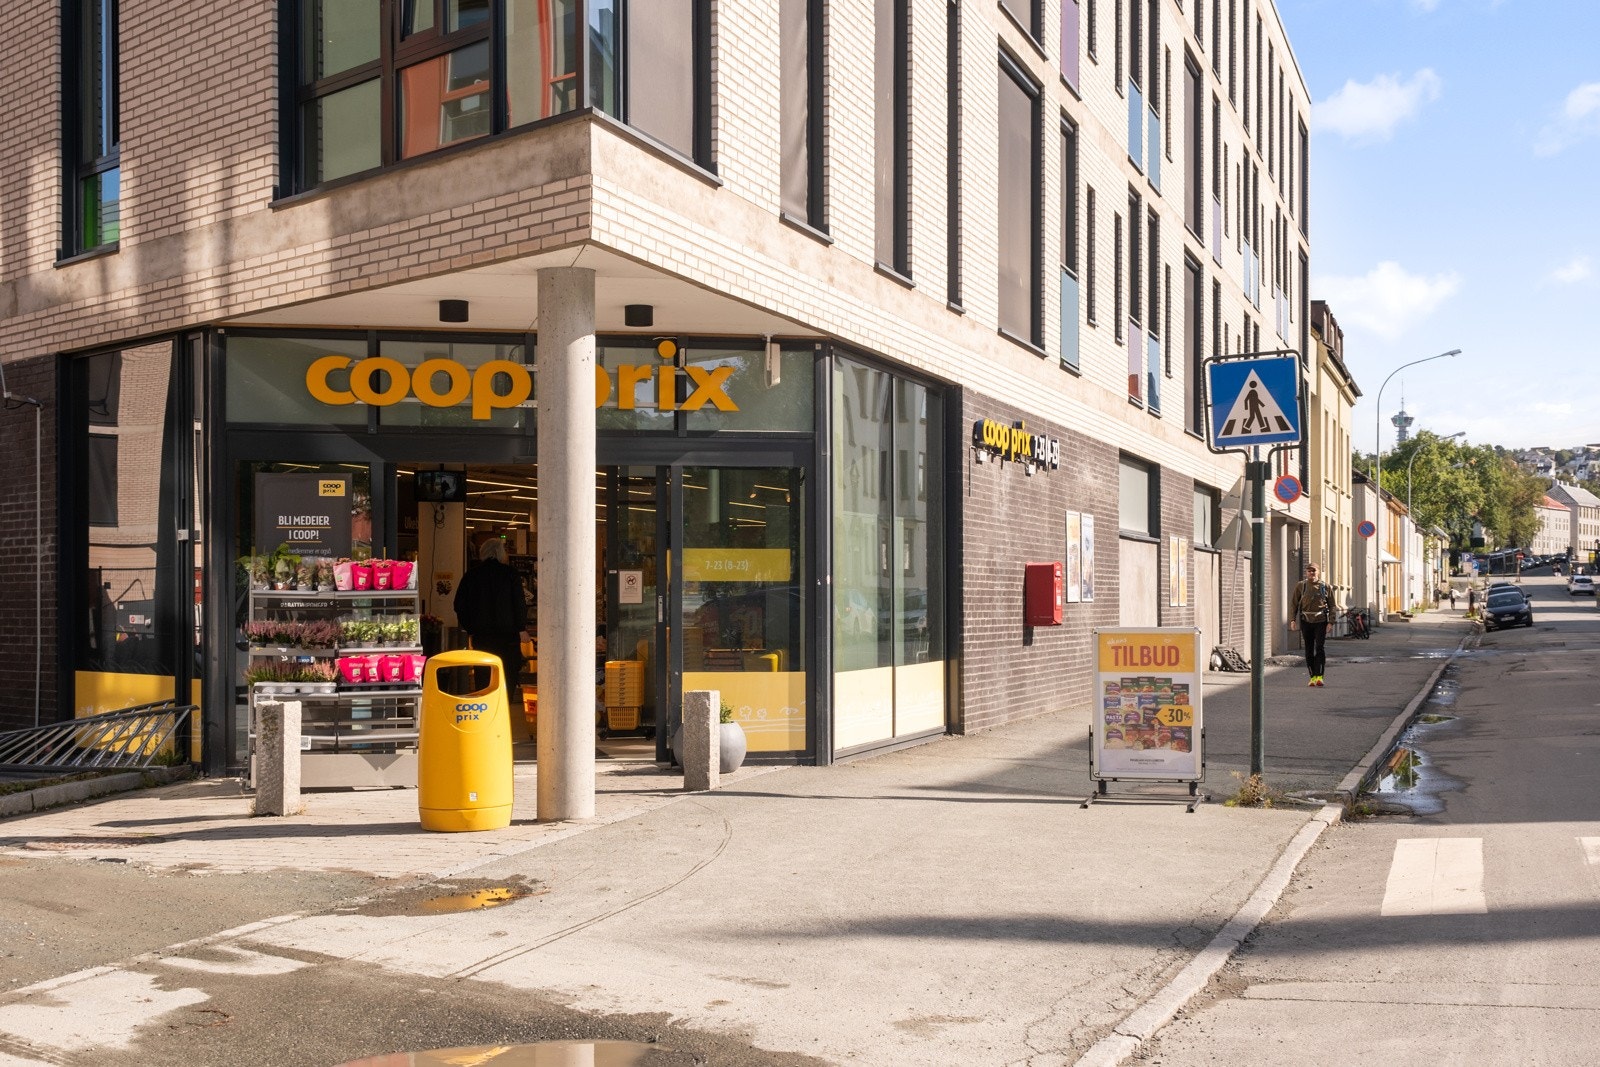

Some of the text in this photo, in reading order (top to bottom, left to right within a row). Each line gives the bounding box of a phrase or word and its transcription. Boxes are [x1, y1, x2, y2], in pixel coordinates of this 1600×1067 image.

[306, 340, 740, 420] coop rix
[983, 418, 1010, 456] coop
[1011, 420, 1032, 462] prix
[278, 515, 330, 526] BLI MEDEIER
[293, 530, 319, 540] COOP!
[705, 560, 723, 570] 7-23
[1111, 645, 1180, 667] TILBUD
[456, 703, 487, 713] coop
[456, 712, 479, 723] prix
[1164, 708, 1191, 723] -30%
